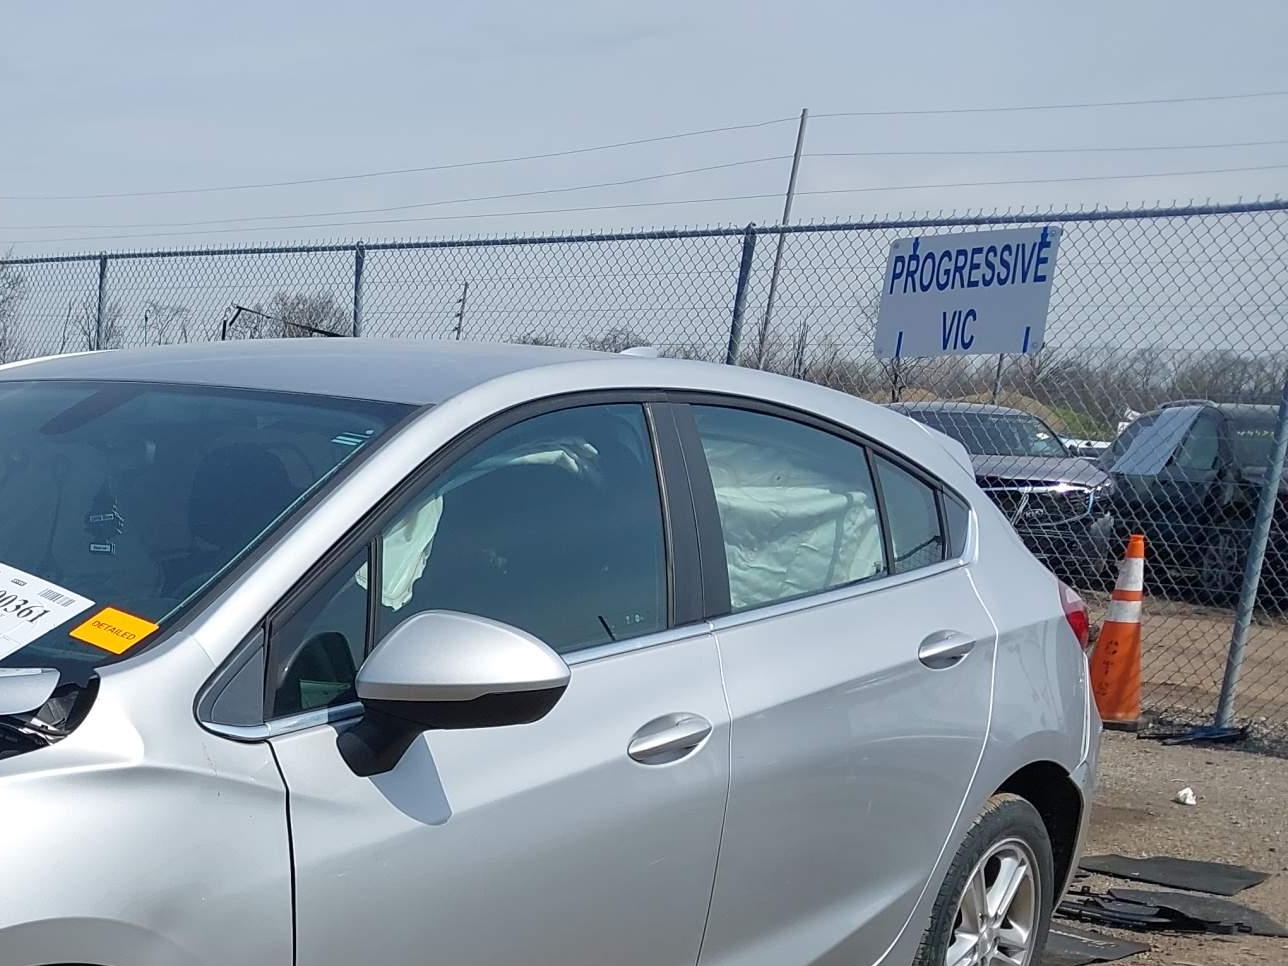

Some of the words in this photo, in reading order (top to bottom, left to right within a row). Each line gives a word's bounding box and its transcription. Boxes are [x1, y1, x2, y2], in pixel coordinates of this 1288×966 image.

[889, 241, 1051, 295] PROGRESSIVE
[941, 308, 977, 351] VIC
[92, 620, 136, 641] DETAILED
